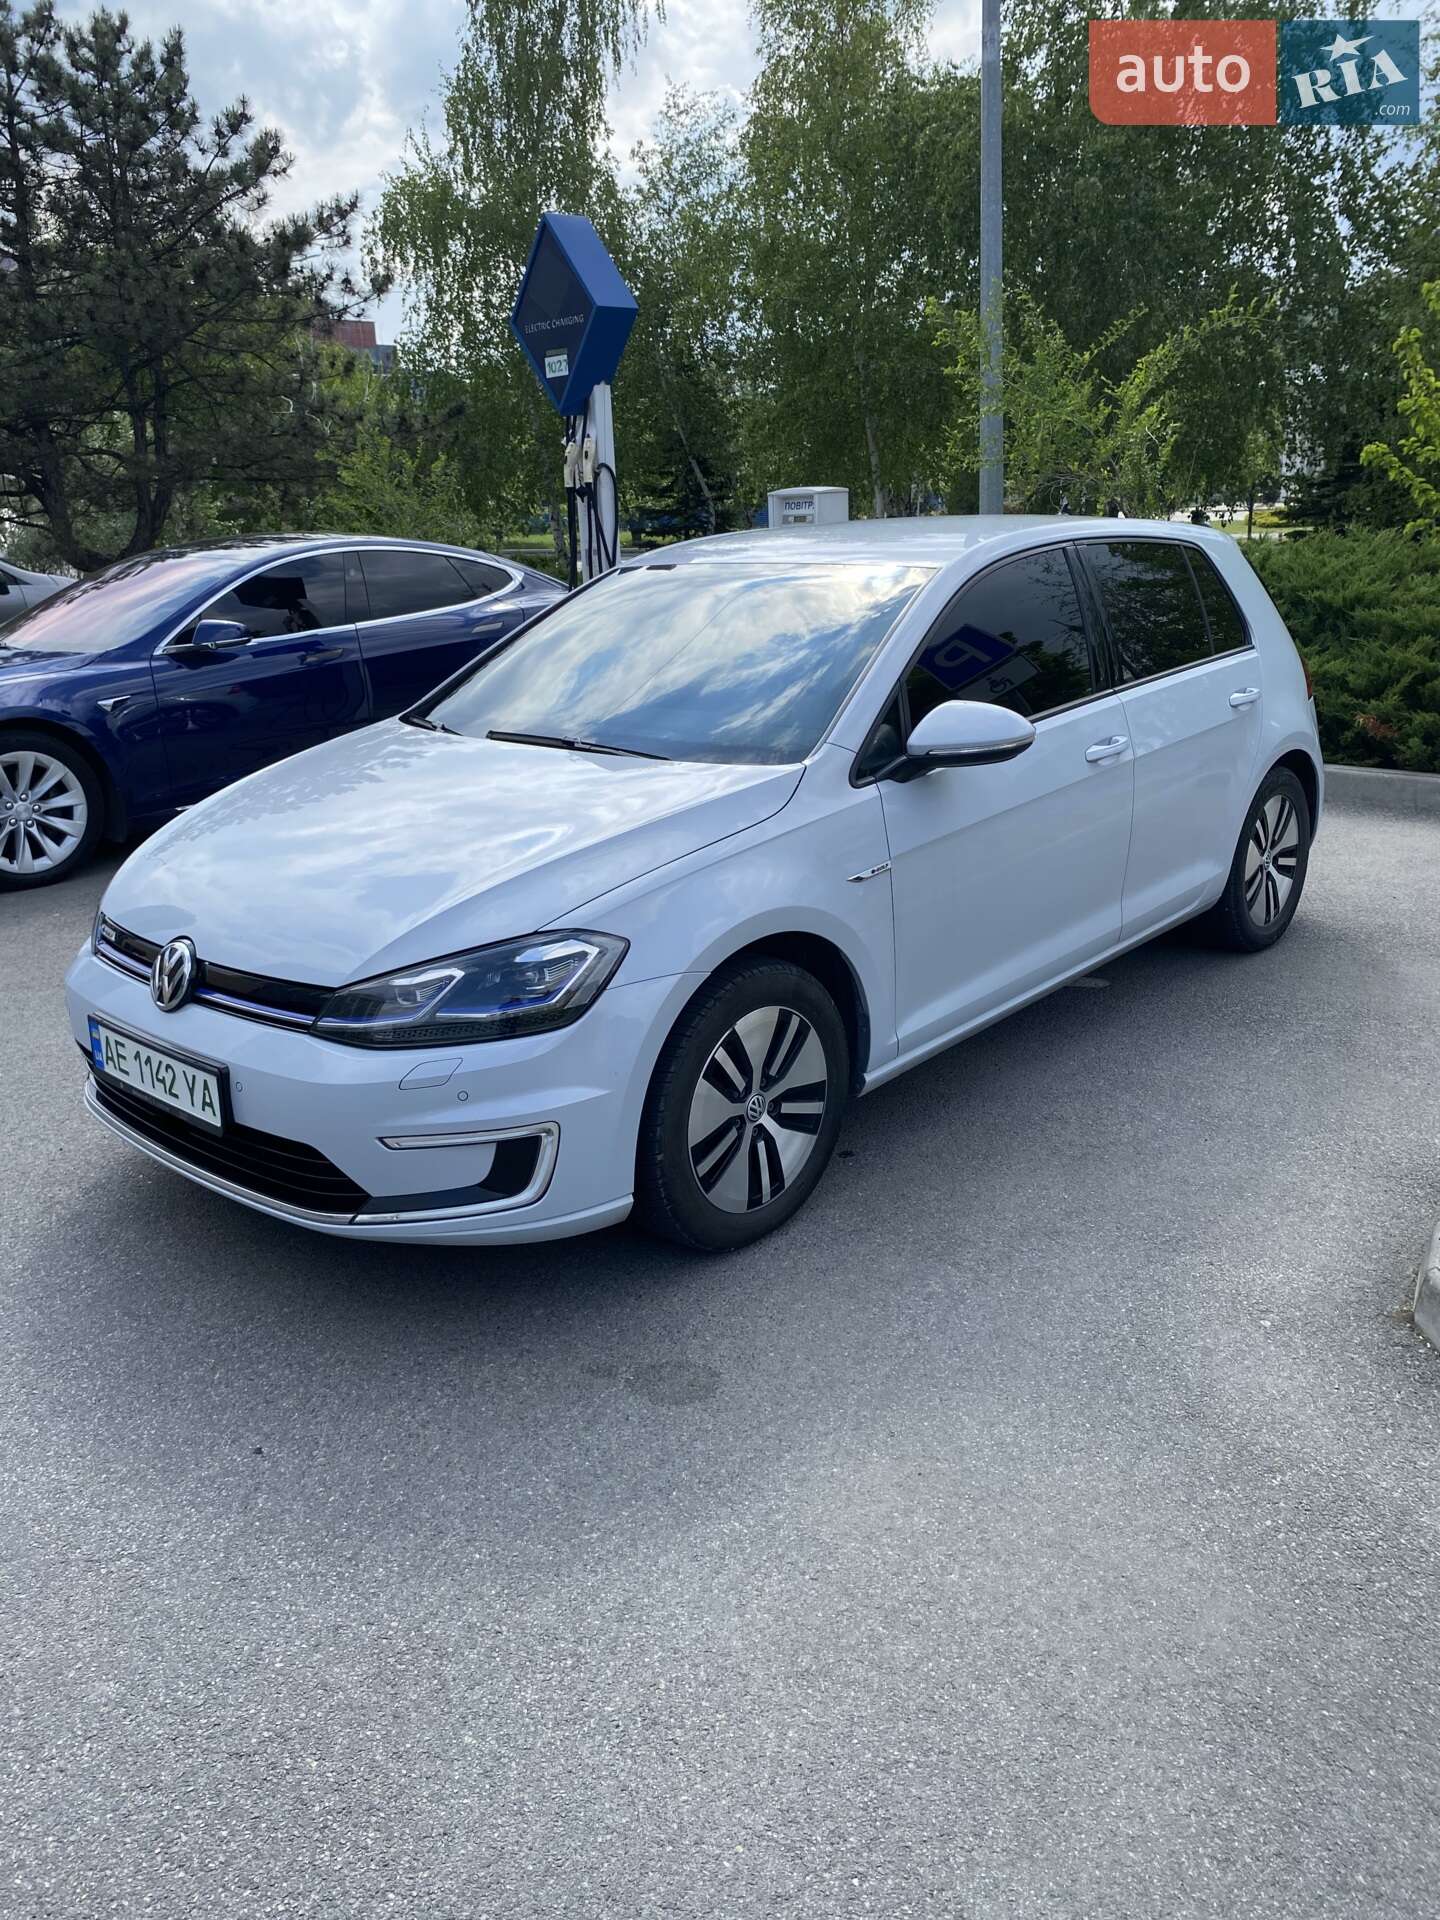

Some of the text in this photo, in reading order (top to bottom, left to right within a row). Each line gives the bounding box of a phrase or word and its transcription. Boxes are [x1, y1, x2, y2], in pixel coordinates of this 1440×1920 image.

[524, 313, 584, 334] ELECTRIC CHARGING
[105, 1034, 217, 1117] AE 1142 YA
